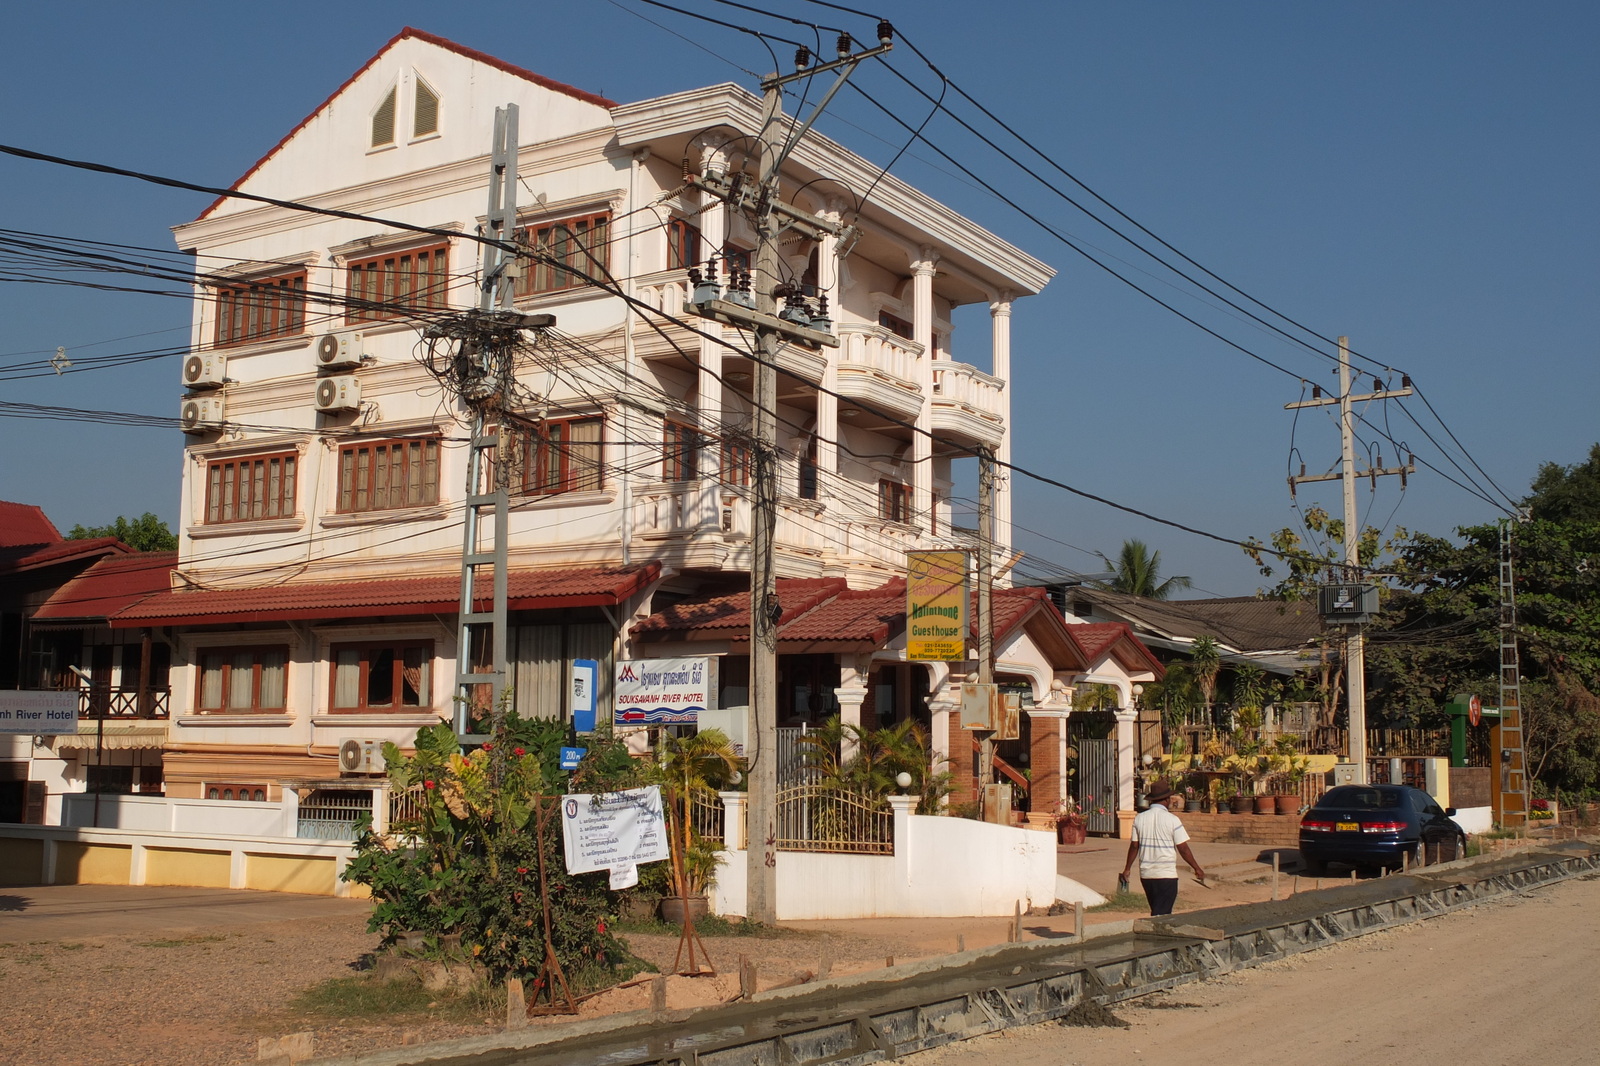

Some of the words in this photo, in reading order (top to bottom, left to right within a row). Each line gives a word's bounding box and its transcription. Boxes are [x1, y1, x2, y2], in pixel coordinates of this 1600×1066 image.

[912, 602, 958, 620] Nalinthone
[912, 625, 958, 636] Guesthouse
[618, 695, 660, 704] SOUKSAVANH
[662, 694, 681, 703] RIVER
[683, 693, 703, 702] HOTEL
[16, 710, 42, 719] River
[47, 710, 73, 719] Hotel
[566, 751, 576, 760] 200
[765, 852, 776, 868] 26
